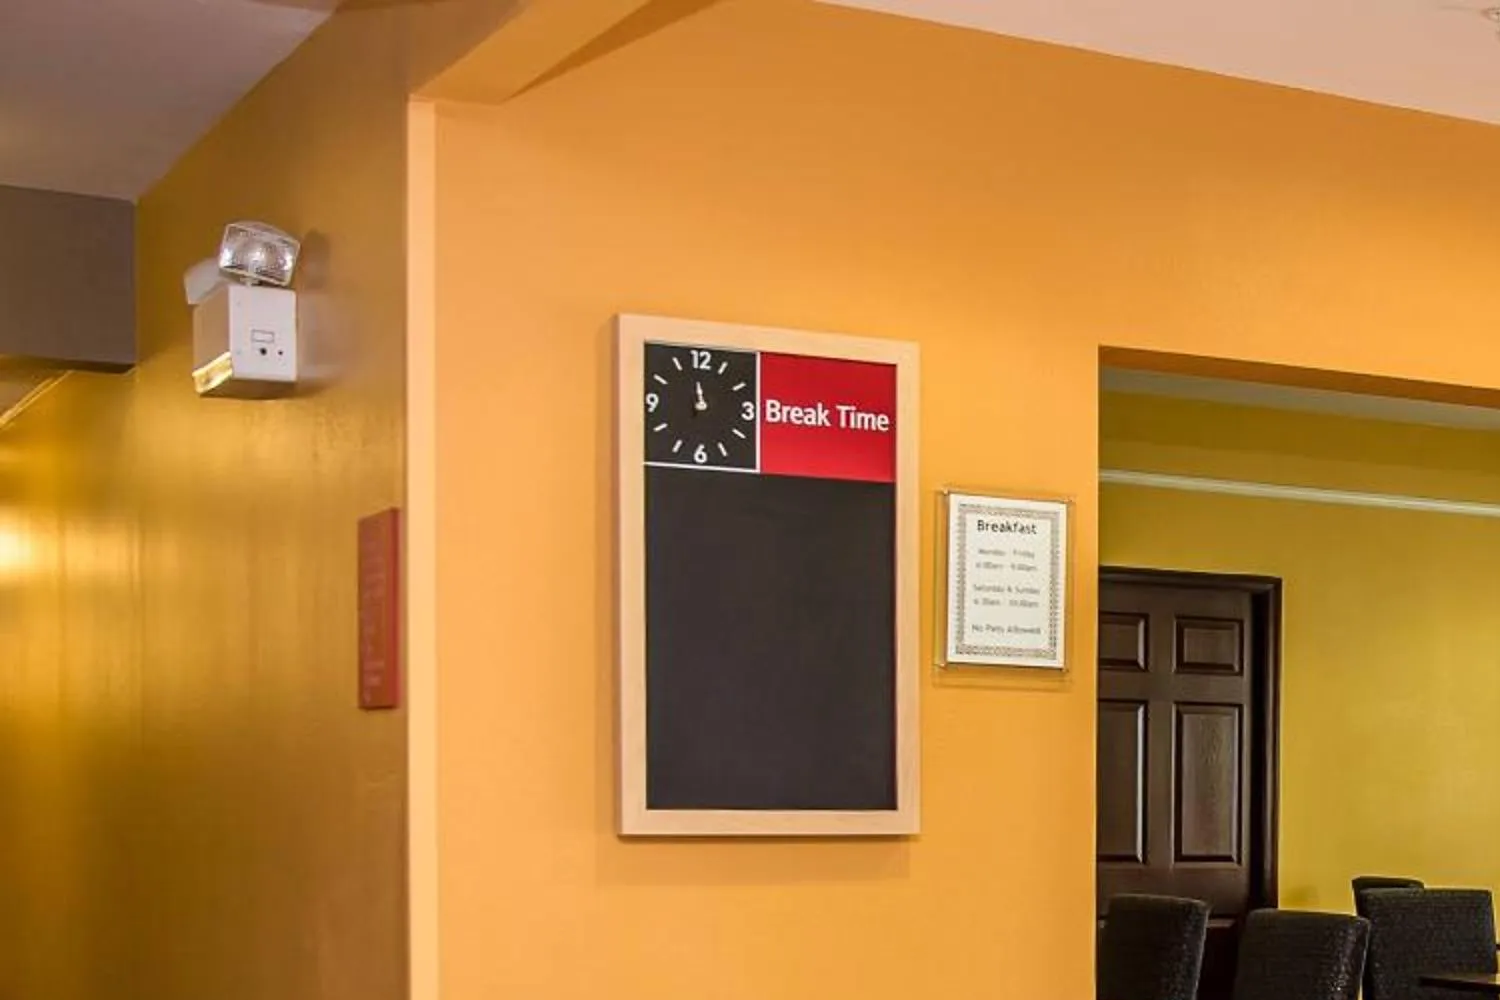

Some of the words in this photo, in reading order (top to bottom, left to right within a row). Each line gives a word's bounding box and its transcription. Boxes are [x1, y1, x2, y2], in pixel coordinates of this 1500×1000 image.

[690, 350, 712, 371] 12
[645, 393, 659, 413] 9
[741, 401, 755, 421] 3
[765, 399, 831, 427] Break
[836, 405, 890, 431] Time
[693, 444, 708, 464] 6
[977, 519, 1038, 535] Breakfast
